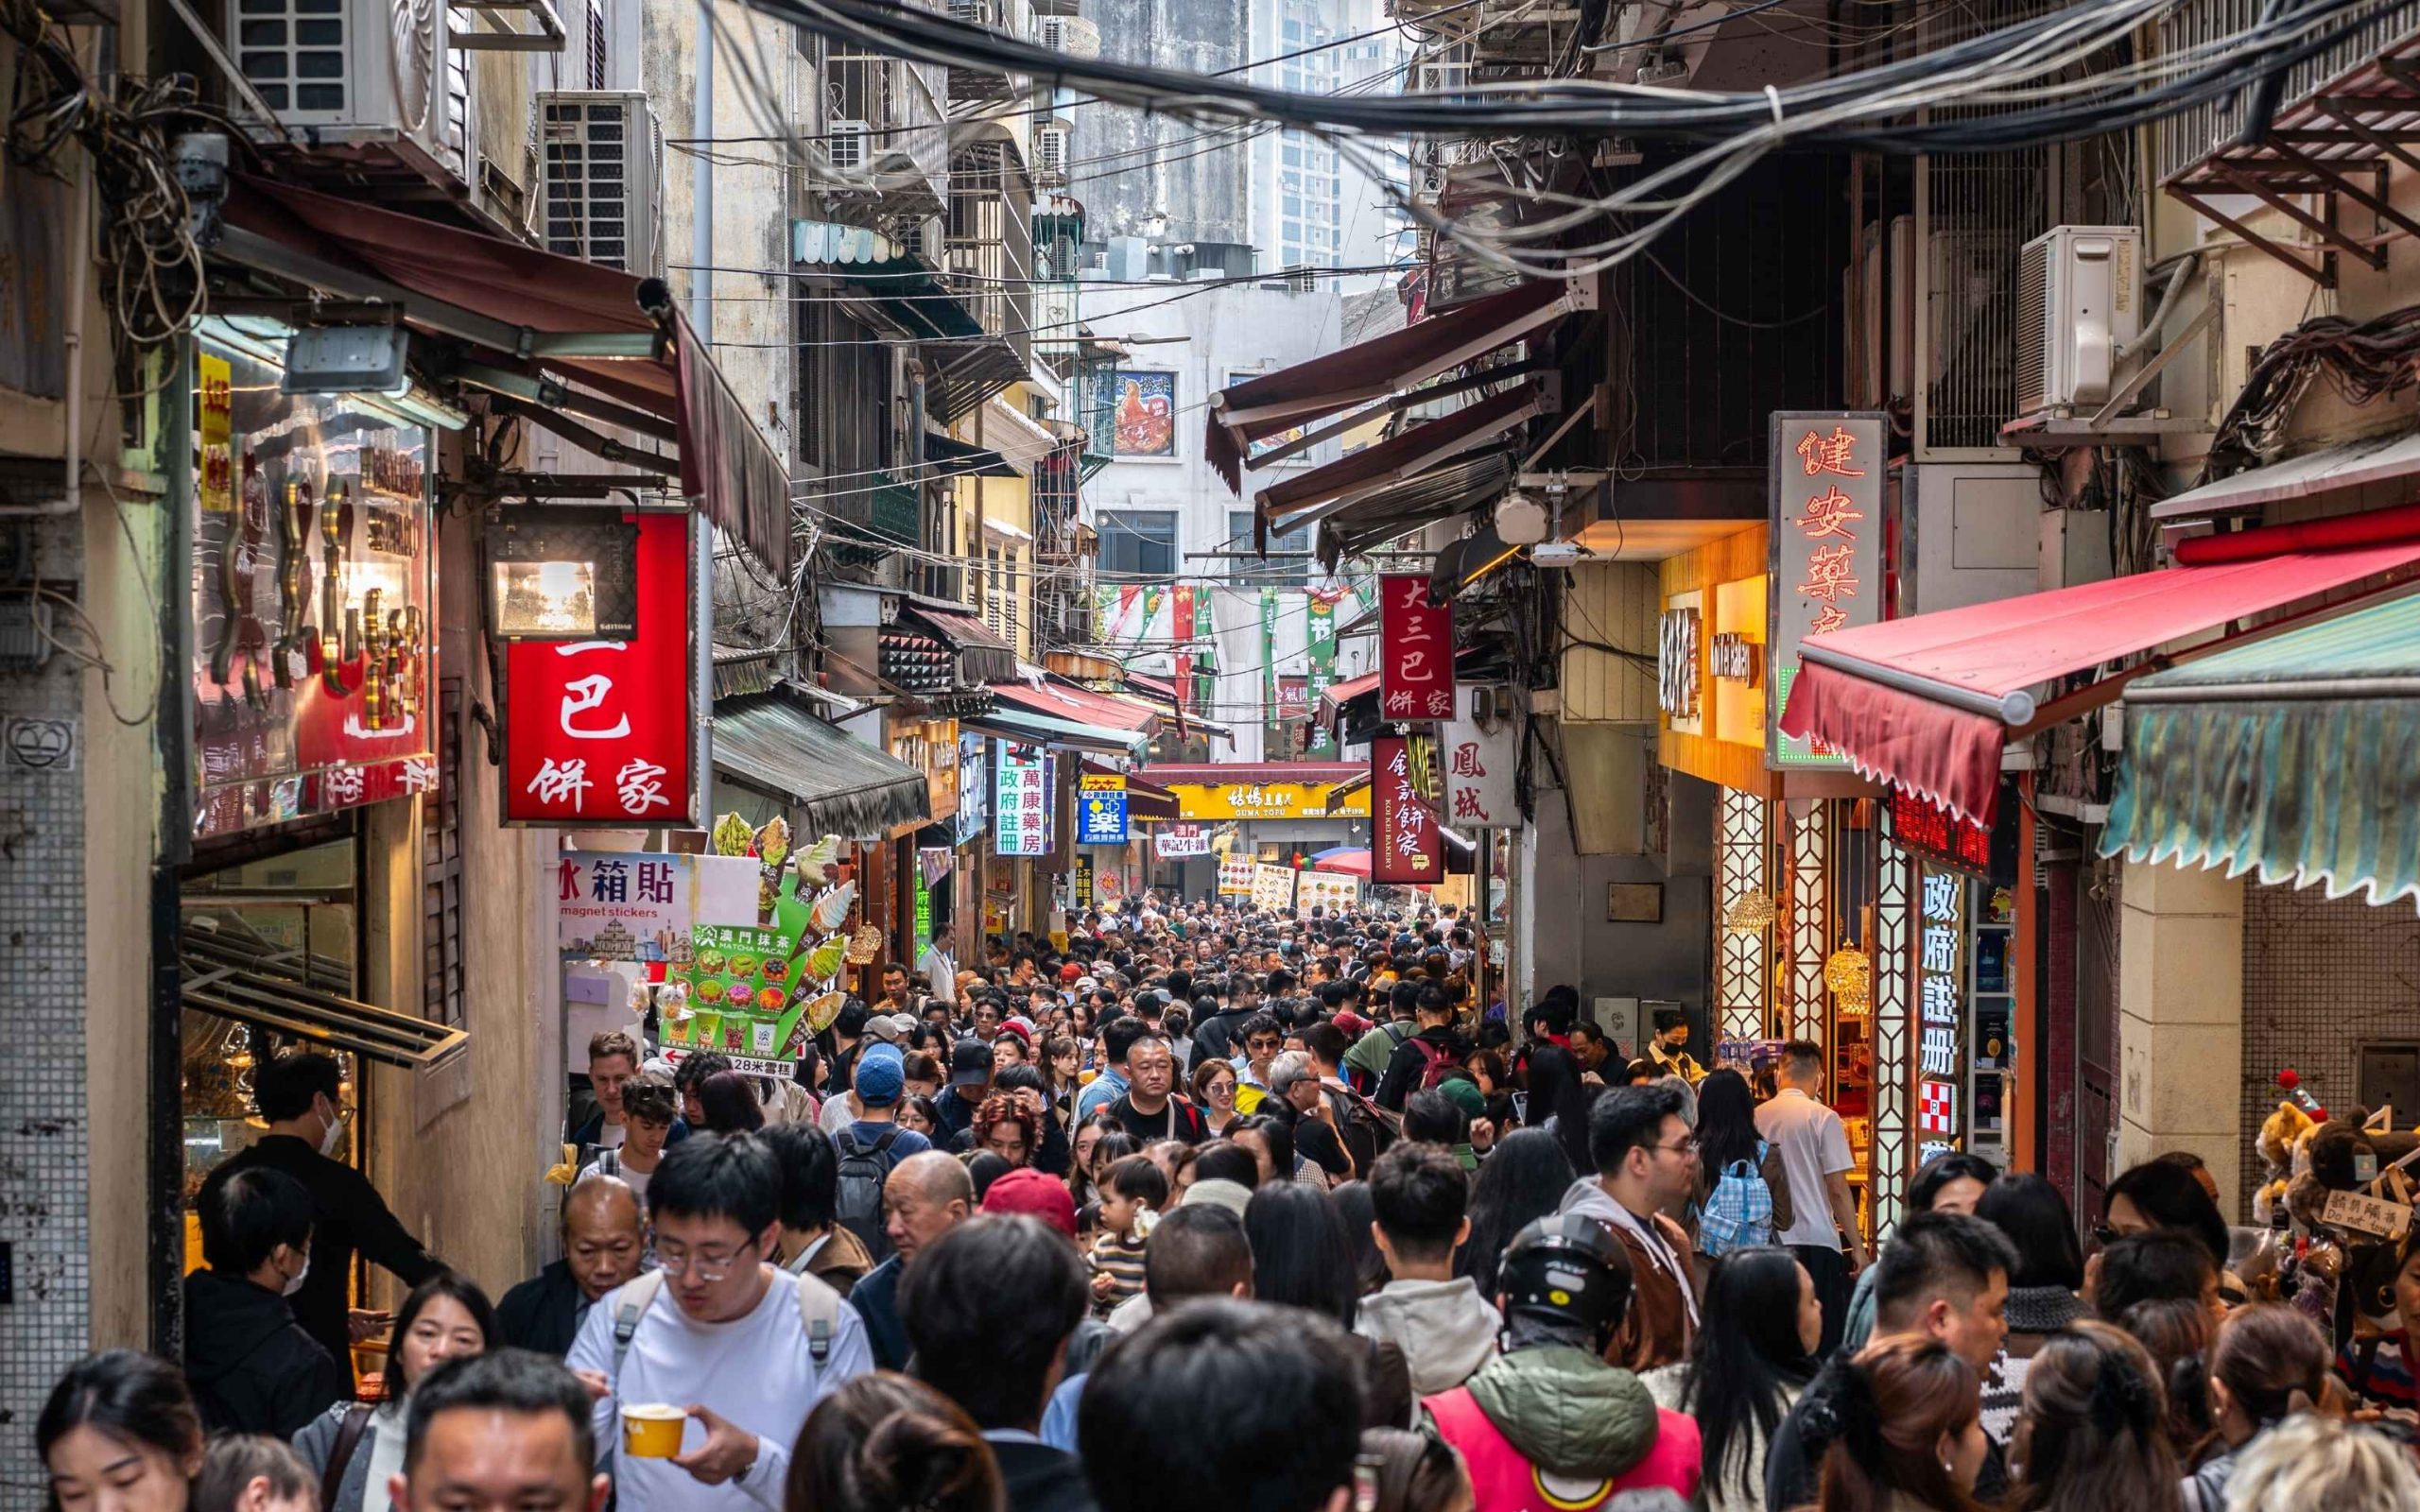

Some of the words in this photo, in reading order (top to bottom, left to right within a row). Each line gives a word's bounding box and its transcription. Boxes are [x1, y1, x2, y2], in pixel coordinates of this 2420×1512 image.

[1399, 580, 1433, 681] 大三巴
[555, 641, 632, 739] 巴
[1387, 690, 1451, 715] 餅家
[527, 757, 670, 815] 餅家
[1452, 742, 1490, 821] 鳳城
[1000, 769, 1018, 852] 政府註冊
[1022, 769, 1041, 852] 萬康藥房
[1177, 824, 1198, 836] 澳門
[561, 907, 605, 918] magnet
[609, 907, 658, 918] stickers
[718, 942, 754, 953] MATCHA
[757, 946, 788, 955] MACAU
[719, 929, 789, 949] 澳門抹茶
[735, 1058, 790, 1075] 28米雪糕
[2327, 1209, 2342, 1221] Do
[2347, 1216, 2365, 1226] not
